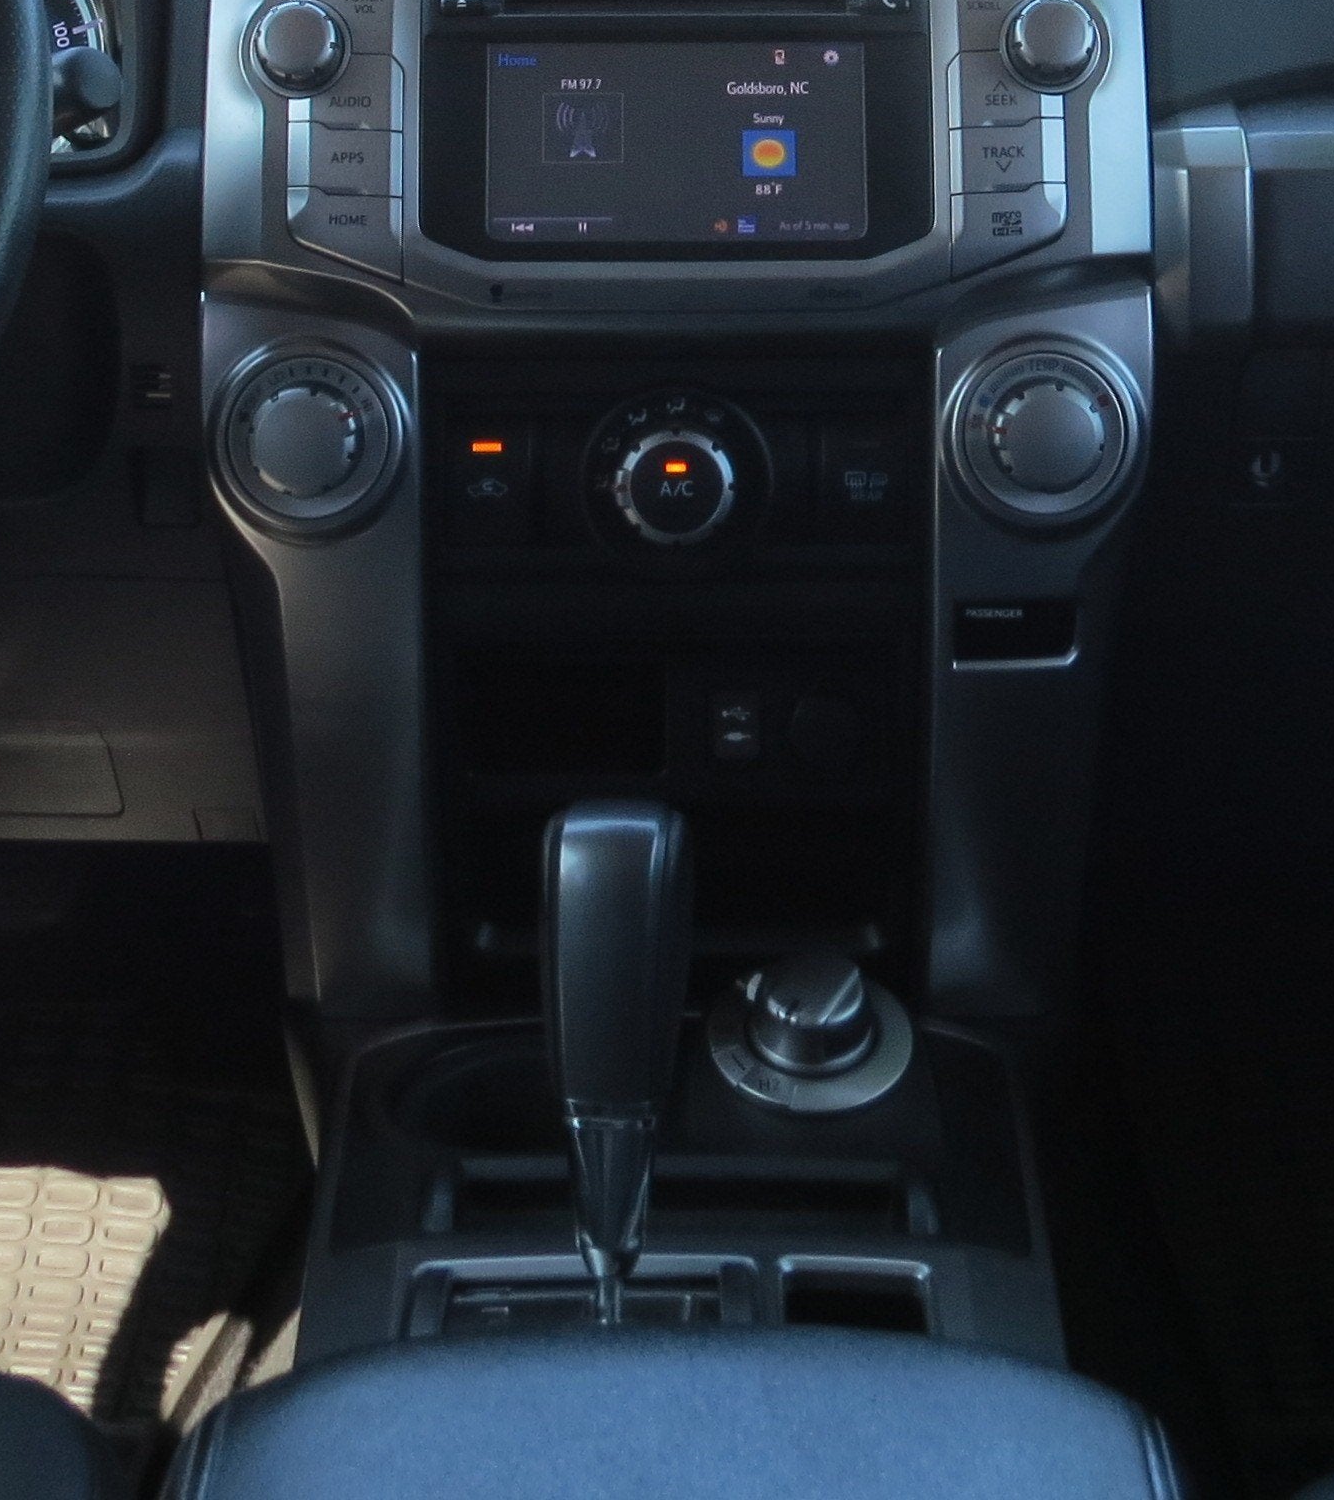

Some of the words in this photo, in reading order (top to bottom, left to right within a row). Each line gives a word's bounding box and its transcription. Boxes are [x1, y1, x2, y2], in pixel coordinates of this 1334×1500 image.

[353, 4, 376, 15] VOL
[51, 20, 71, 49] 100
[497, 53, 537, 67] Home
[560, 78, 577, 90] FM
[726, 81, 787, 96] Goldsboro,
[789, 81, 810, 95] NC
[328, 96, 372, 109] AUDIO
[984, 94, 1017, 107] SEEK
[752, 112, 785, 126] Sunny
[330, 151, 365, 165] APPS
[981, 146, 1026, 159] TRACK
[328, 213, 367, 227] HOME
[659, 480, 695, 497] A/C
